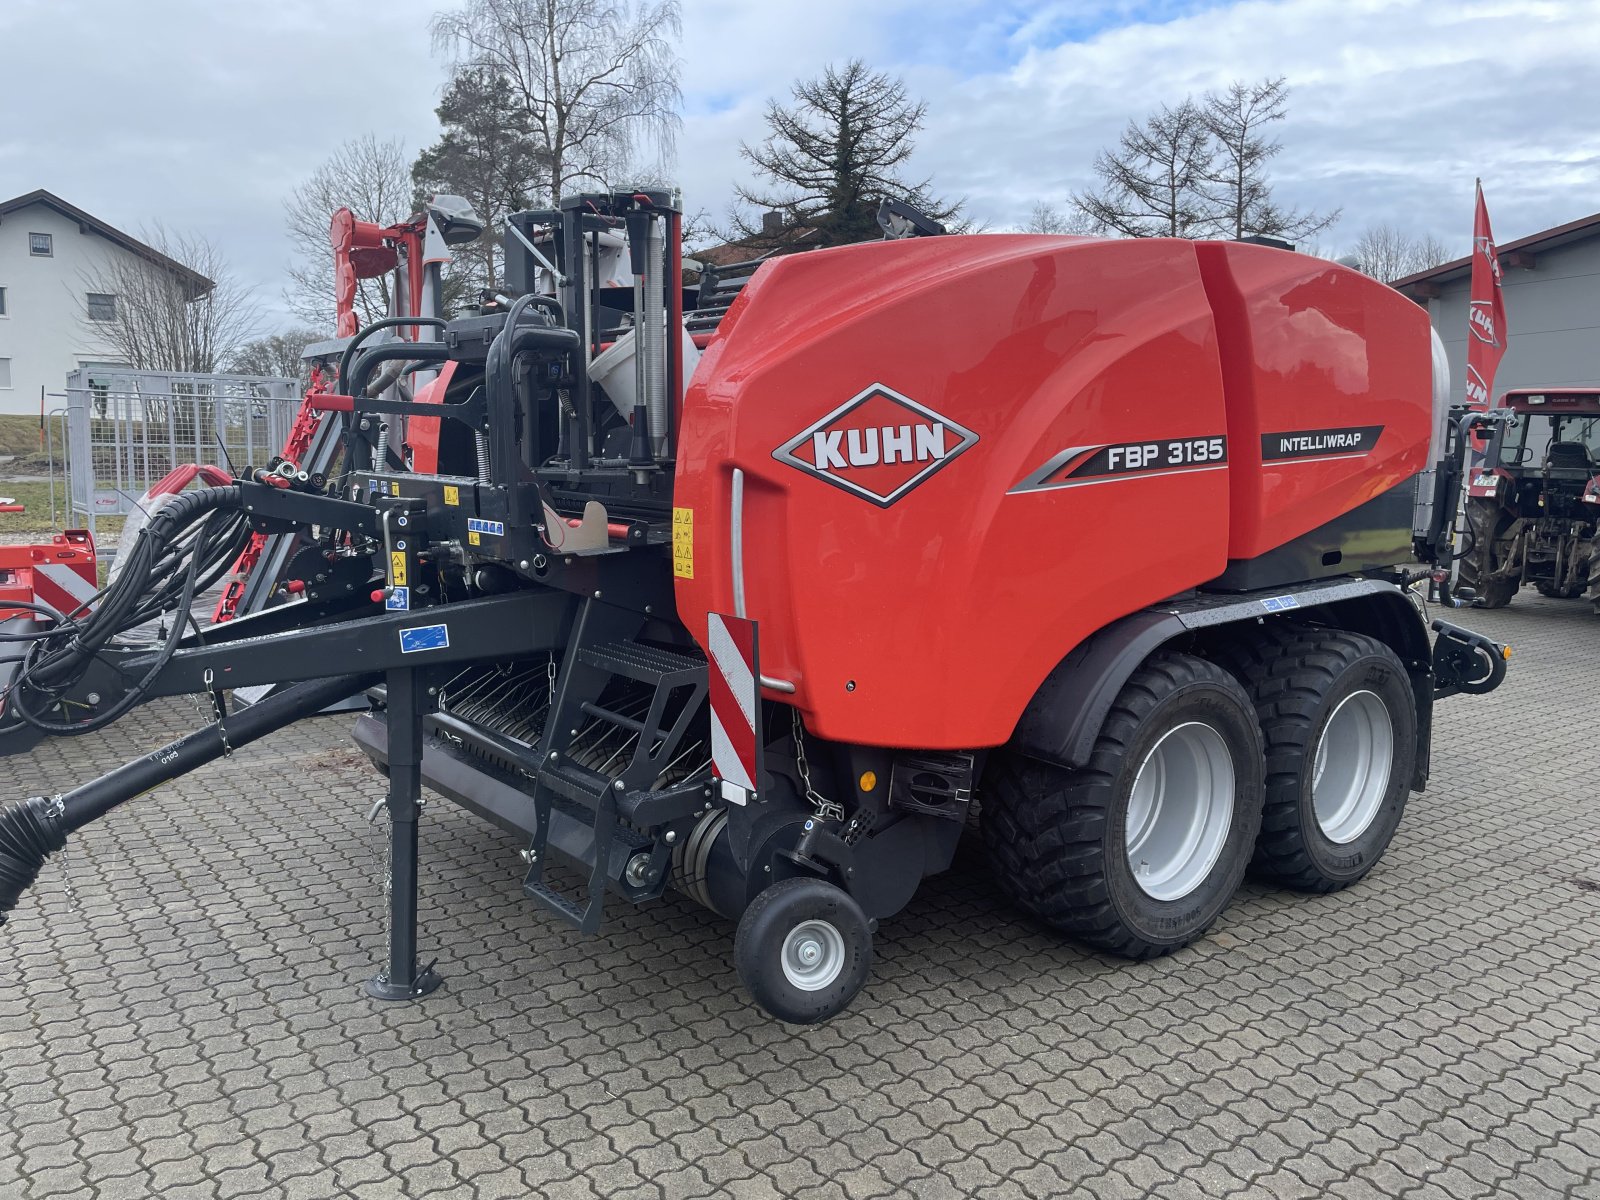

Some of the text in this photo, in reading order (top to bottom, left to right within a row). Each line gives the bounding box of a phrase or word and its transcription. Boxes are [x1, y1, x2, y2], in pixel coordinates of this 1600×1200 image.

[813, 423, 945, 470] KUHN
[1108, 438, 1223, 470] FBP 3135
[1280, 433, 1361, 452] INTELLIWRAP
